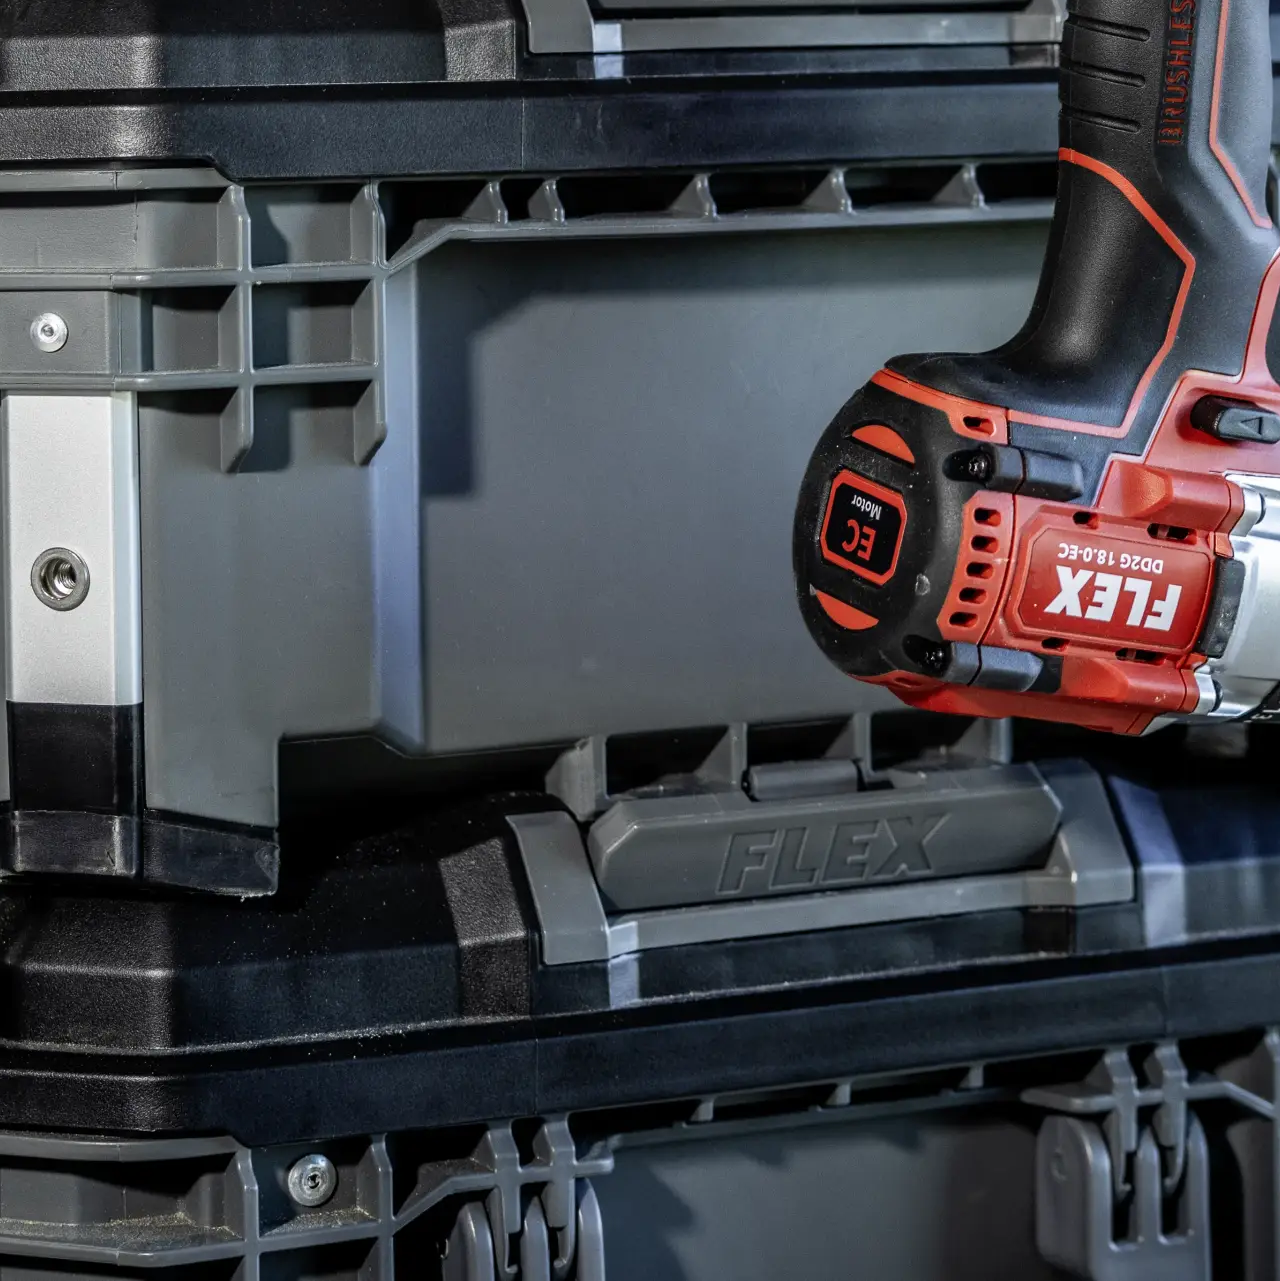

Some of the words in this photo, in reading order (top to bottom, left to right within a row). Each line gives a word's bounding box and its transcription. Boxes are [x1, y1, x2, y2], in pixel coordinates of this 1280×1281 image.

[850, 494, 882, 521] Motor
[841, 519, 877, 561] EC
[1057, 542, 1115, 567] 18.0-EC
[1119, 553, 1164, 575] DD2G
[1043, 565, 1183, 632] FLEX
[717, 814, 949, 894] FLEX
